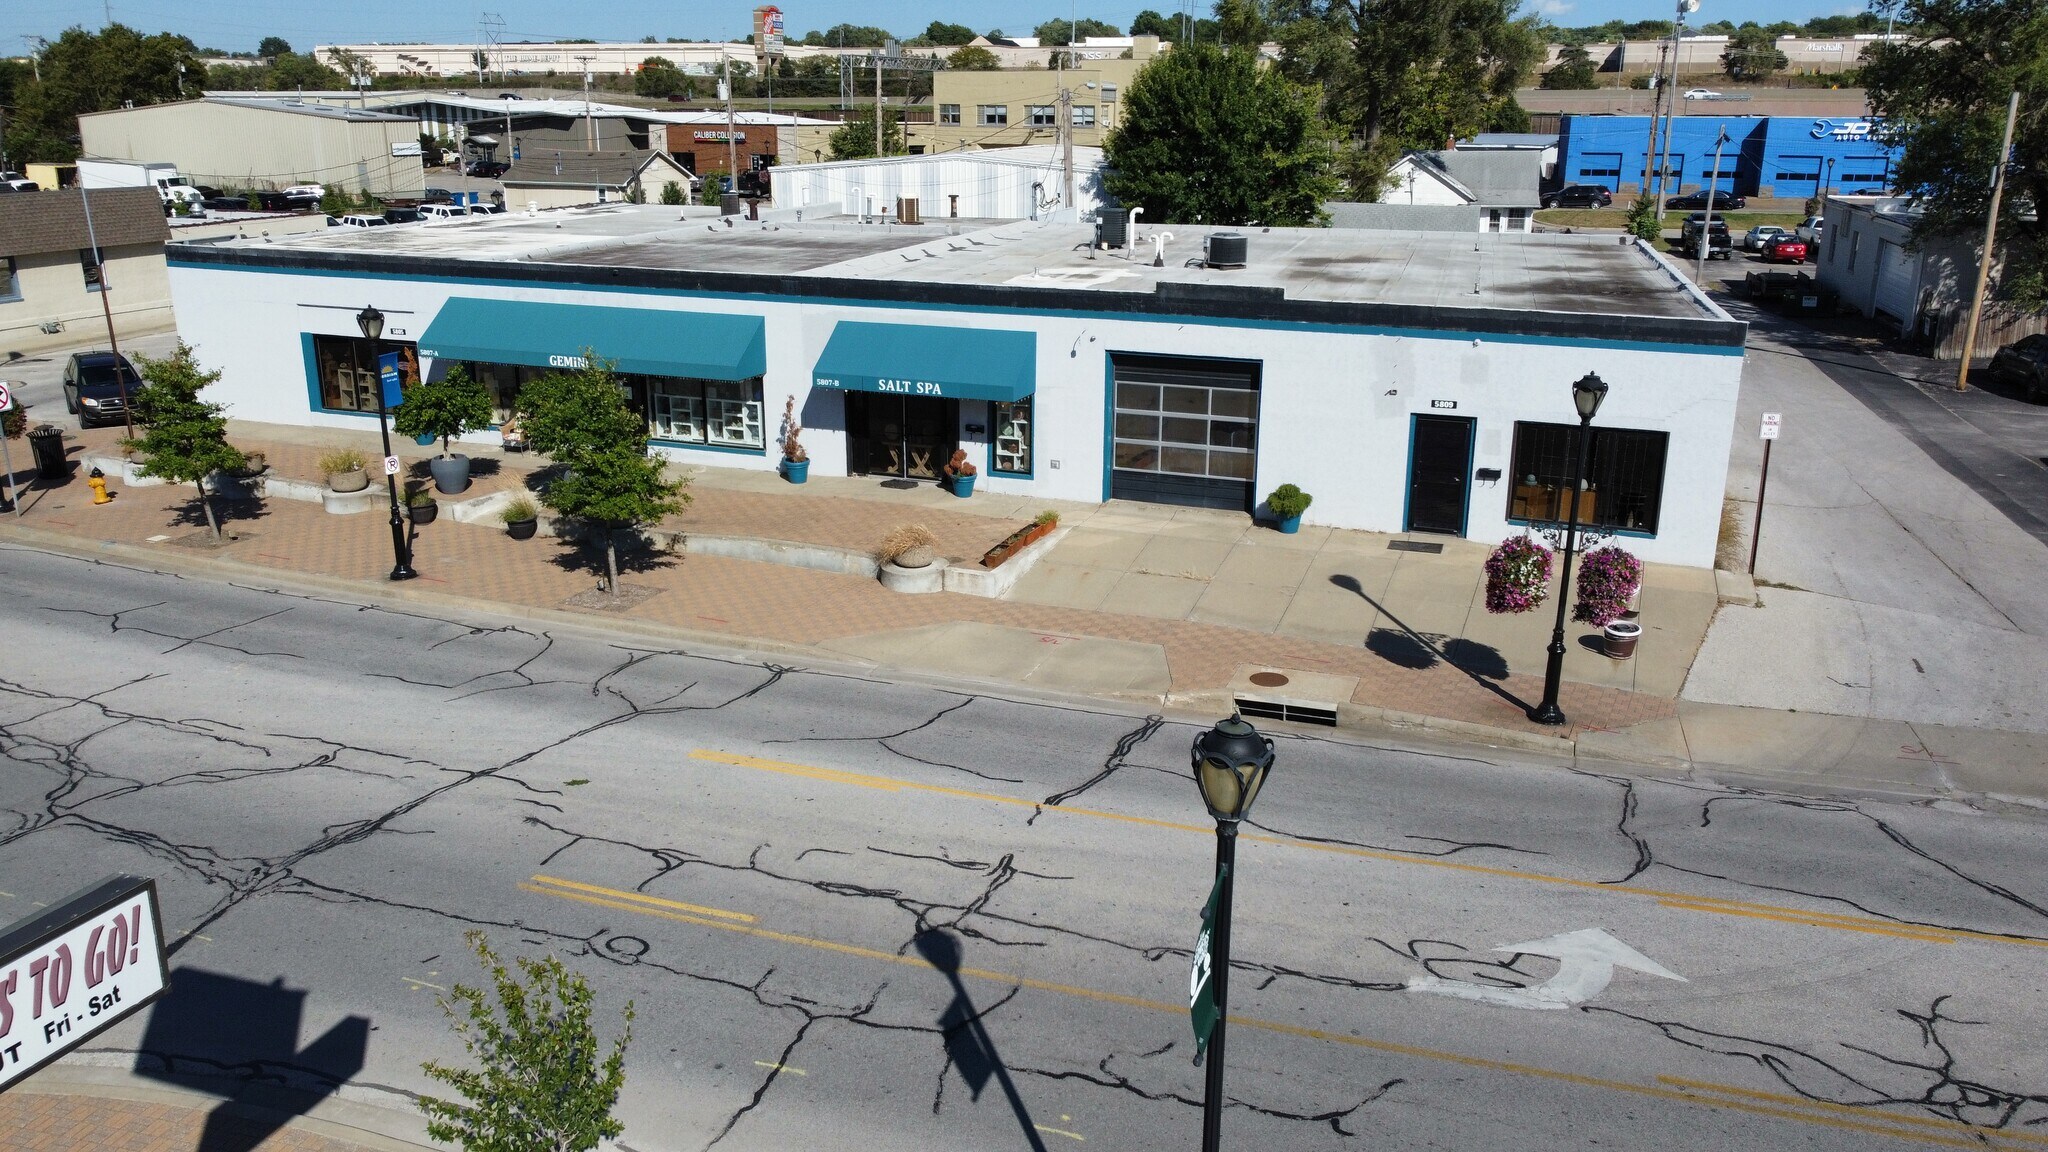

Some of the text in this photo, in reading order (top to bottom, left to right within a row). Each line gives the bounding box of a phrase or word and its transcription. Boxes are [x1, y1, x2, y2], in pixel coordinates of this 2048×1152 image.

[1804, 43, 1843, 51] Marshalls
[694, 131, 746, 139] CALIBER COLLSION
[420, 349, 439, 357] 5807-A
[816, 379, 840, 387] 5807-B
[878, 379, 942, 395] SALT SPA
[1434, 400, 1454, 408] 5809
[29, 943, 73, 1020] TO
[84, 904, 141, 990] GO!
[44, 1012, 72, 1045] Fri
[88, 985, 122, 1017] Sat
